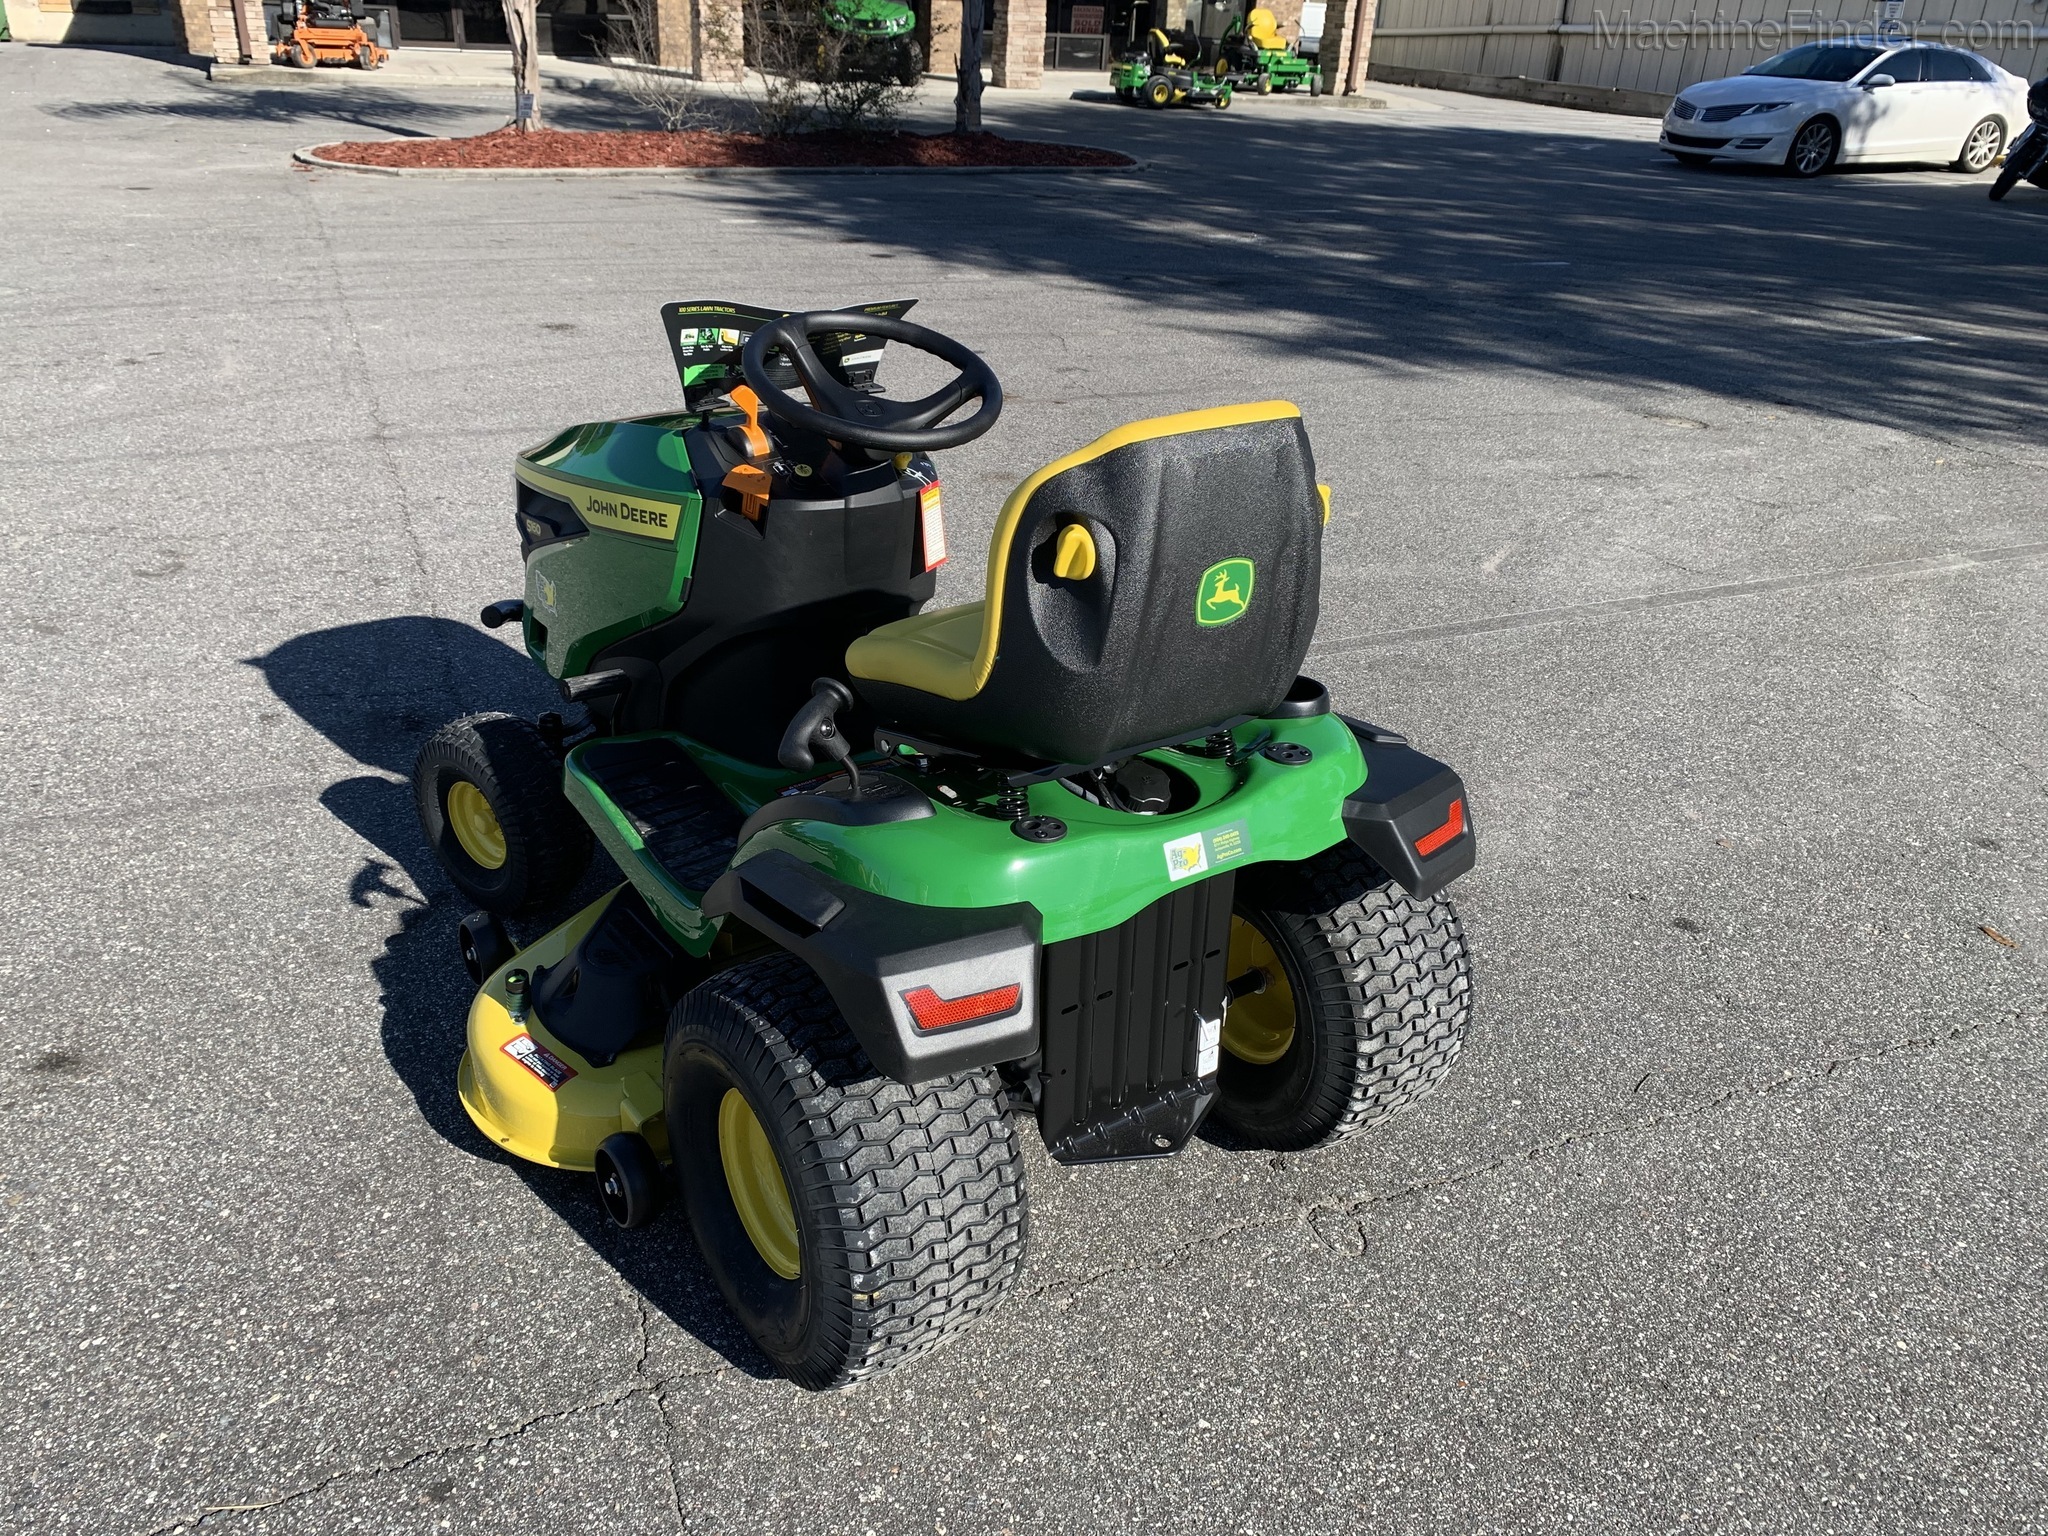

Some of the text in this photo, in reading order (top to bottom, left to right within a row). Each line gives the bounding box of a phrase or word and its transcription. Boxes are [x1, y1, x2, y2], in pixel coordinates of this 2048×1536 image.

[714, 306, 736, 314] TRACTORS
[586, 495, 668, 528] JOHN DEERE
[1172, 858, 1189, 869] Pro
